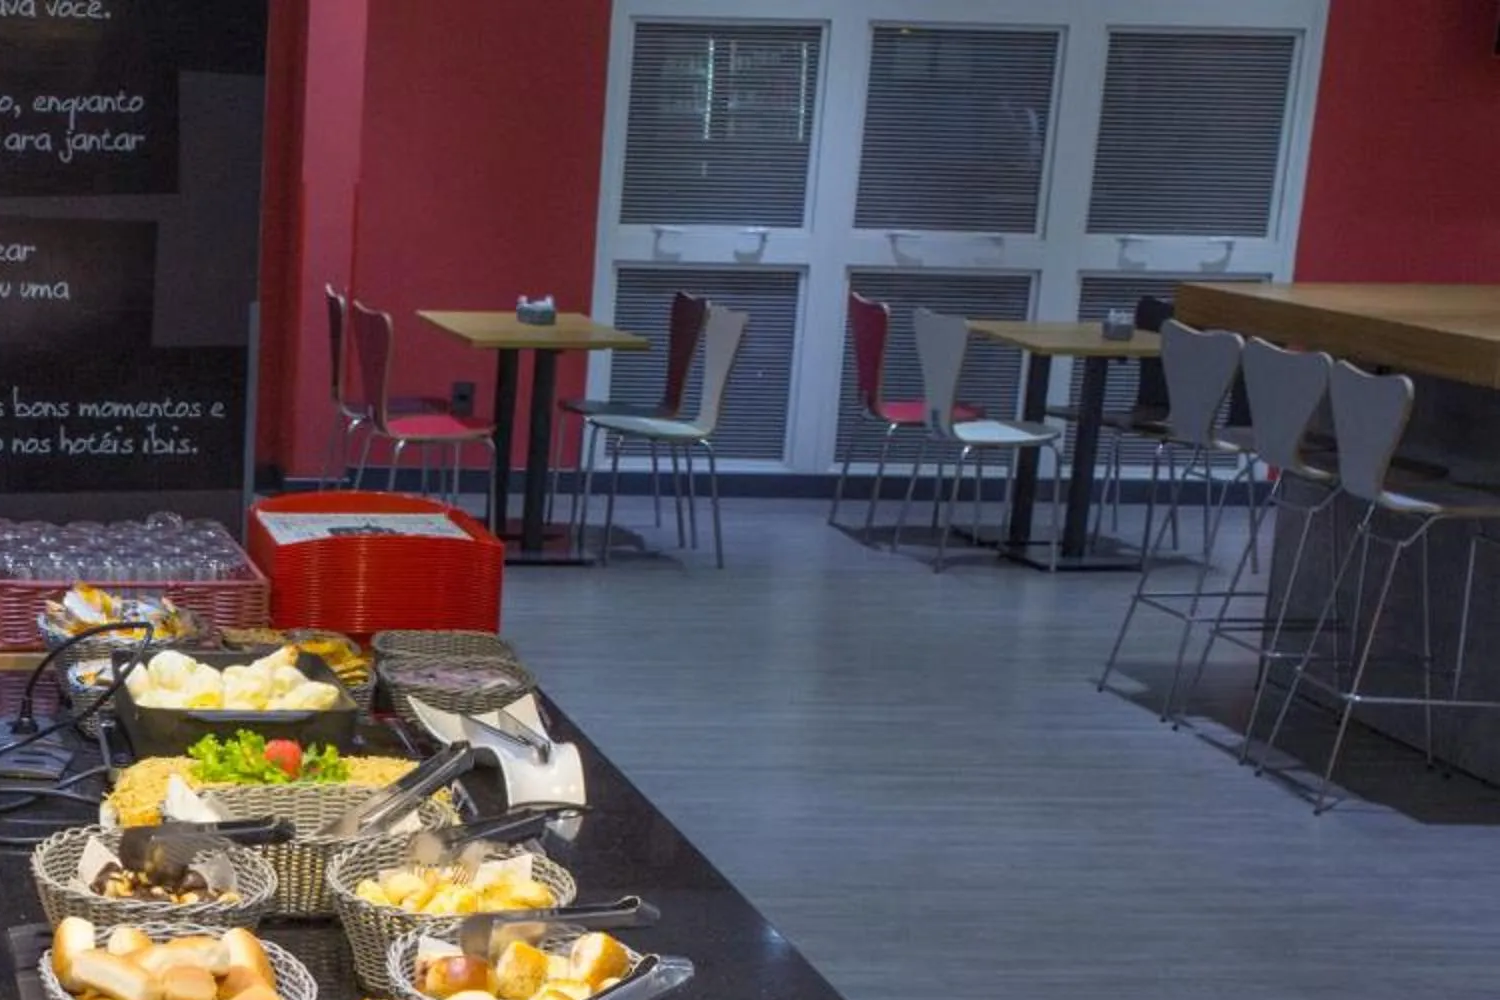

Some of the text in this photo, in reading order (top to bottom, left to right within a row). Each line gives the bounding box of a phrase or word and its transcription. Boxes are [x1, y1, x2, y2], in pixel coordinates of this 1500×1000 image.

[32, 89, 145, 131] enquanto
[59, 129, 145, 163] jantar
[20, 281, 70, 299] uma
[12, 385, 70, 417] bons
[78, 397, 201, 418] momentos
[210, 401, 226, 419] e
[12, 437, 51, 453] nos
[59, 424, 134, 455] hotéis
[142, 423, 199, 455] ibis.
